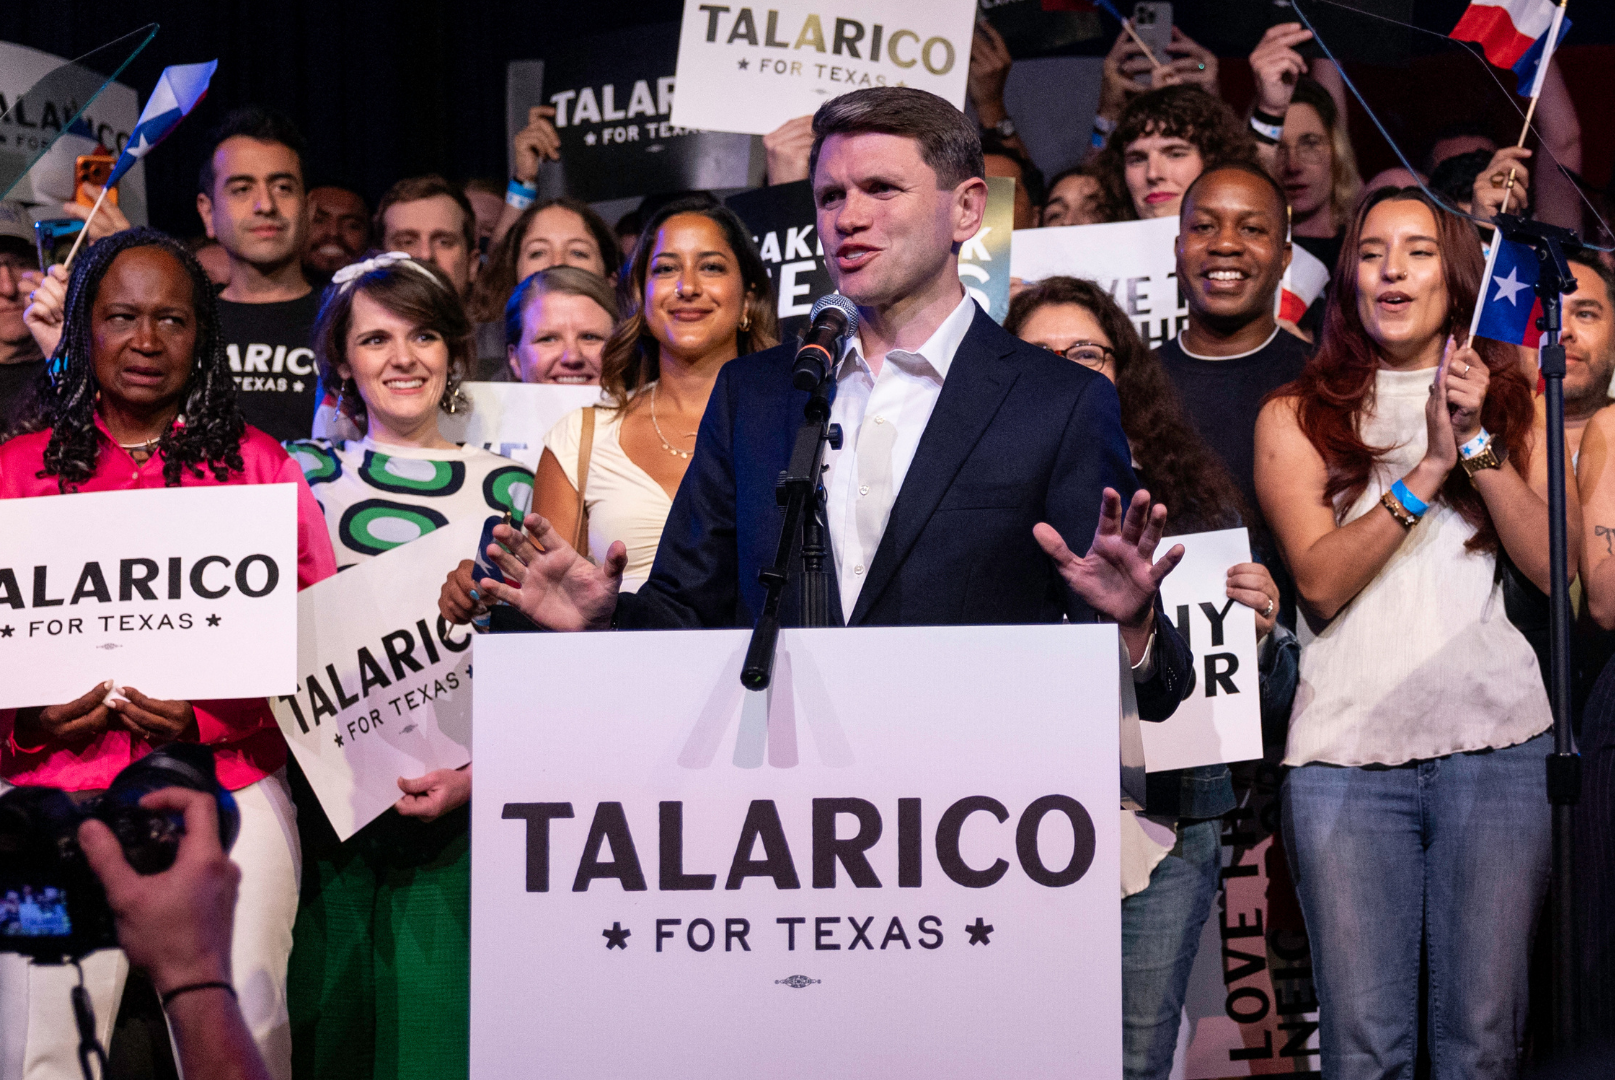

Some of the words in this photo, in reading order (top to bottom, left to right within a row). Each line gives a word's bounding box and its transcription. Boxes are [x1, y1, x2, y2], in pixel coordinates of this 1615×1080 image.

[699, 5, 956, 76] TALARICO
[760, 58, 802, 76] FOR
[814, 63, 887, 88] TEXAS
[602, 123, 640, 146] FOR
[0, 553, 279, 609] ALARICO
[28, 618, 84, 637] FOR
[98, 612, 194, 632] TEXAS
[346, 709, 384, 741] FOR
[389, 672, 460, 716] TEXAS
[501, 793, 1097, 893] TALARICO
[655, 918, 752, 953] FOR
[776, 914, 945, 951] TEXAS
[1219, 907, 1273, 1061] LOVE
